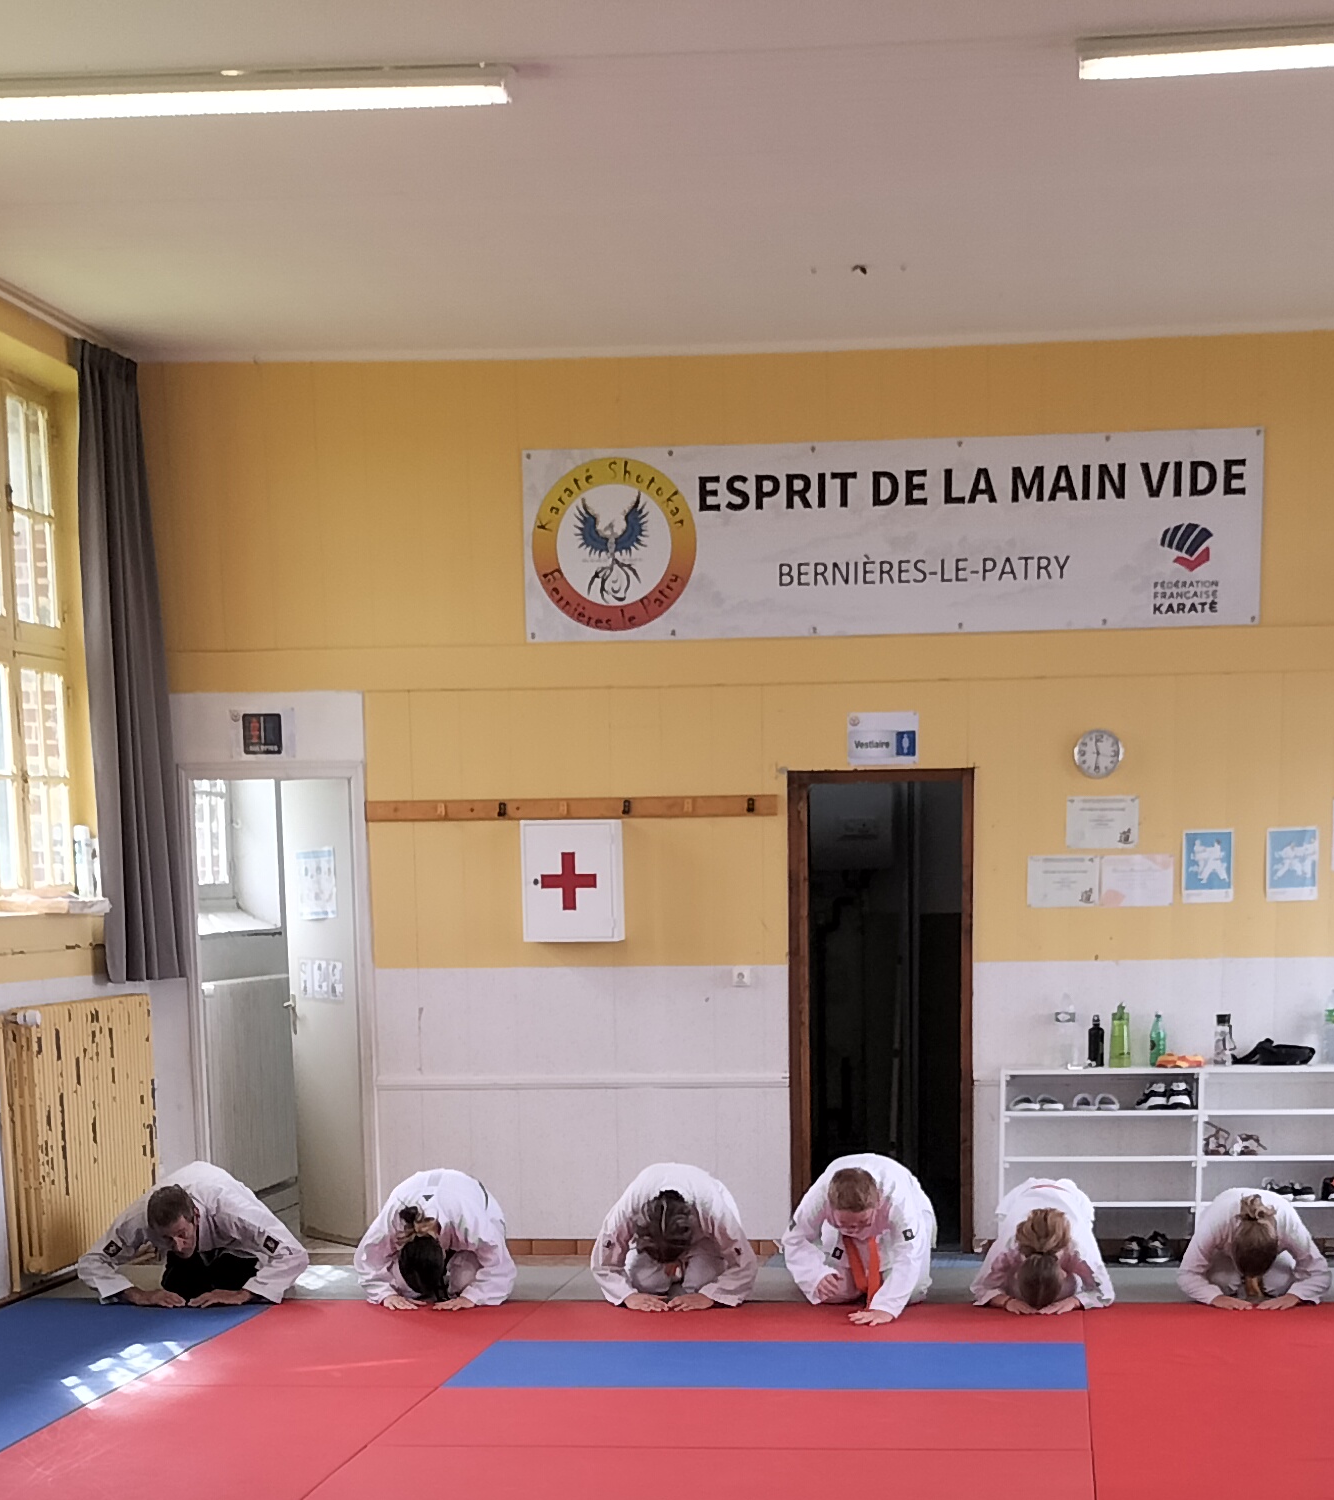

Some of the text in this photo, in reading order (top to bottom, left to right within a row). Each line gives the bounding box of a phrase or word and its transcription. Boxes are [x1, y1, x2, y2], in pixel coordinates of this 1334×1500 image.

[698, 458, 1247, 512] ESPRIT DE LA MAIN VIDE
[536, 468, 594, 532] Karaté
[778, 554, 1071, 587] BERNIÈRES-LE-PATRY
[1153, 580, 1219, 590] FÉDÉRATION
[1153, 589, 1218, 600] FRANÇAISE
[619, 607, 637, 626] le
[638, 573, 683, 619] Patry
[1152, 600, 1218, 615] KARATÉ
[854, 740, 890, 750] Vestiaire
